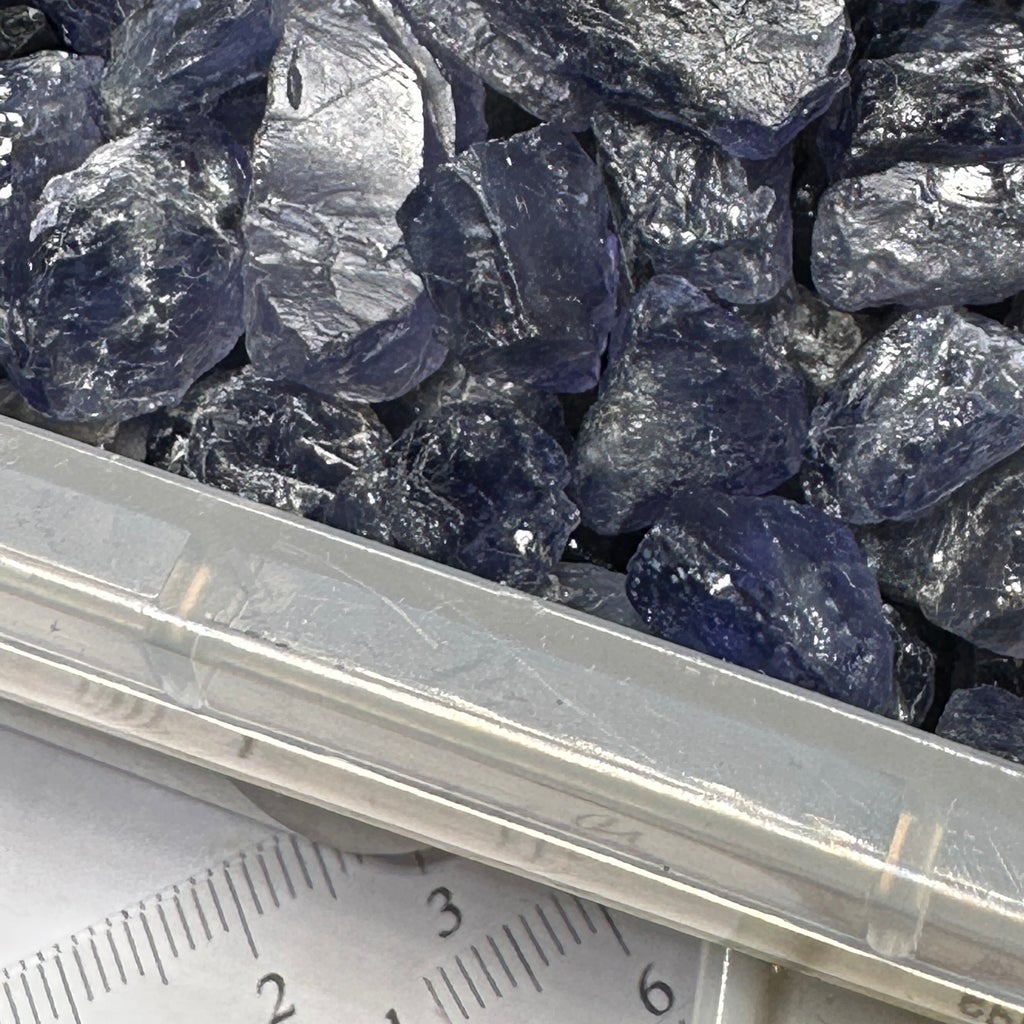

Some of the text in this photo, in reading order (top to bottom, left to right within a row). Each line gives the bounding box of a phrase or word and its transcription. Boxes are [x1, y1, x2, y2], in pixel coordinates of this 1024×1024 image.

[426, 886, 462, 938] 3
[256, 972, 296, 1024] 2
[639, 961, 675, 1016] 6
